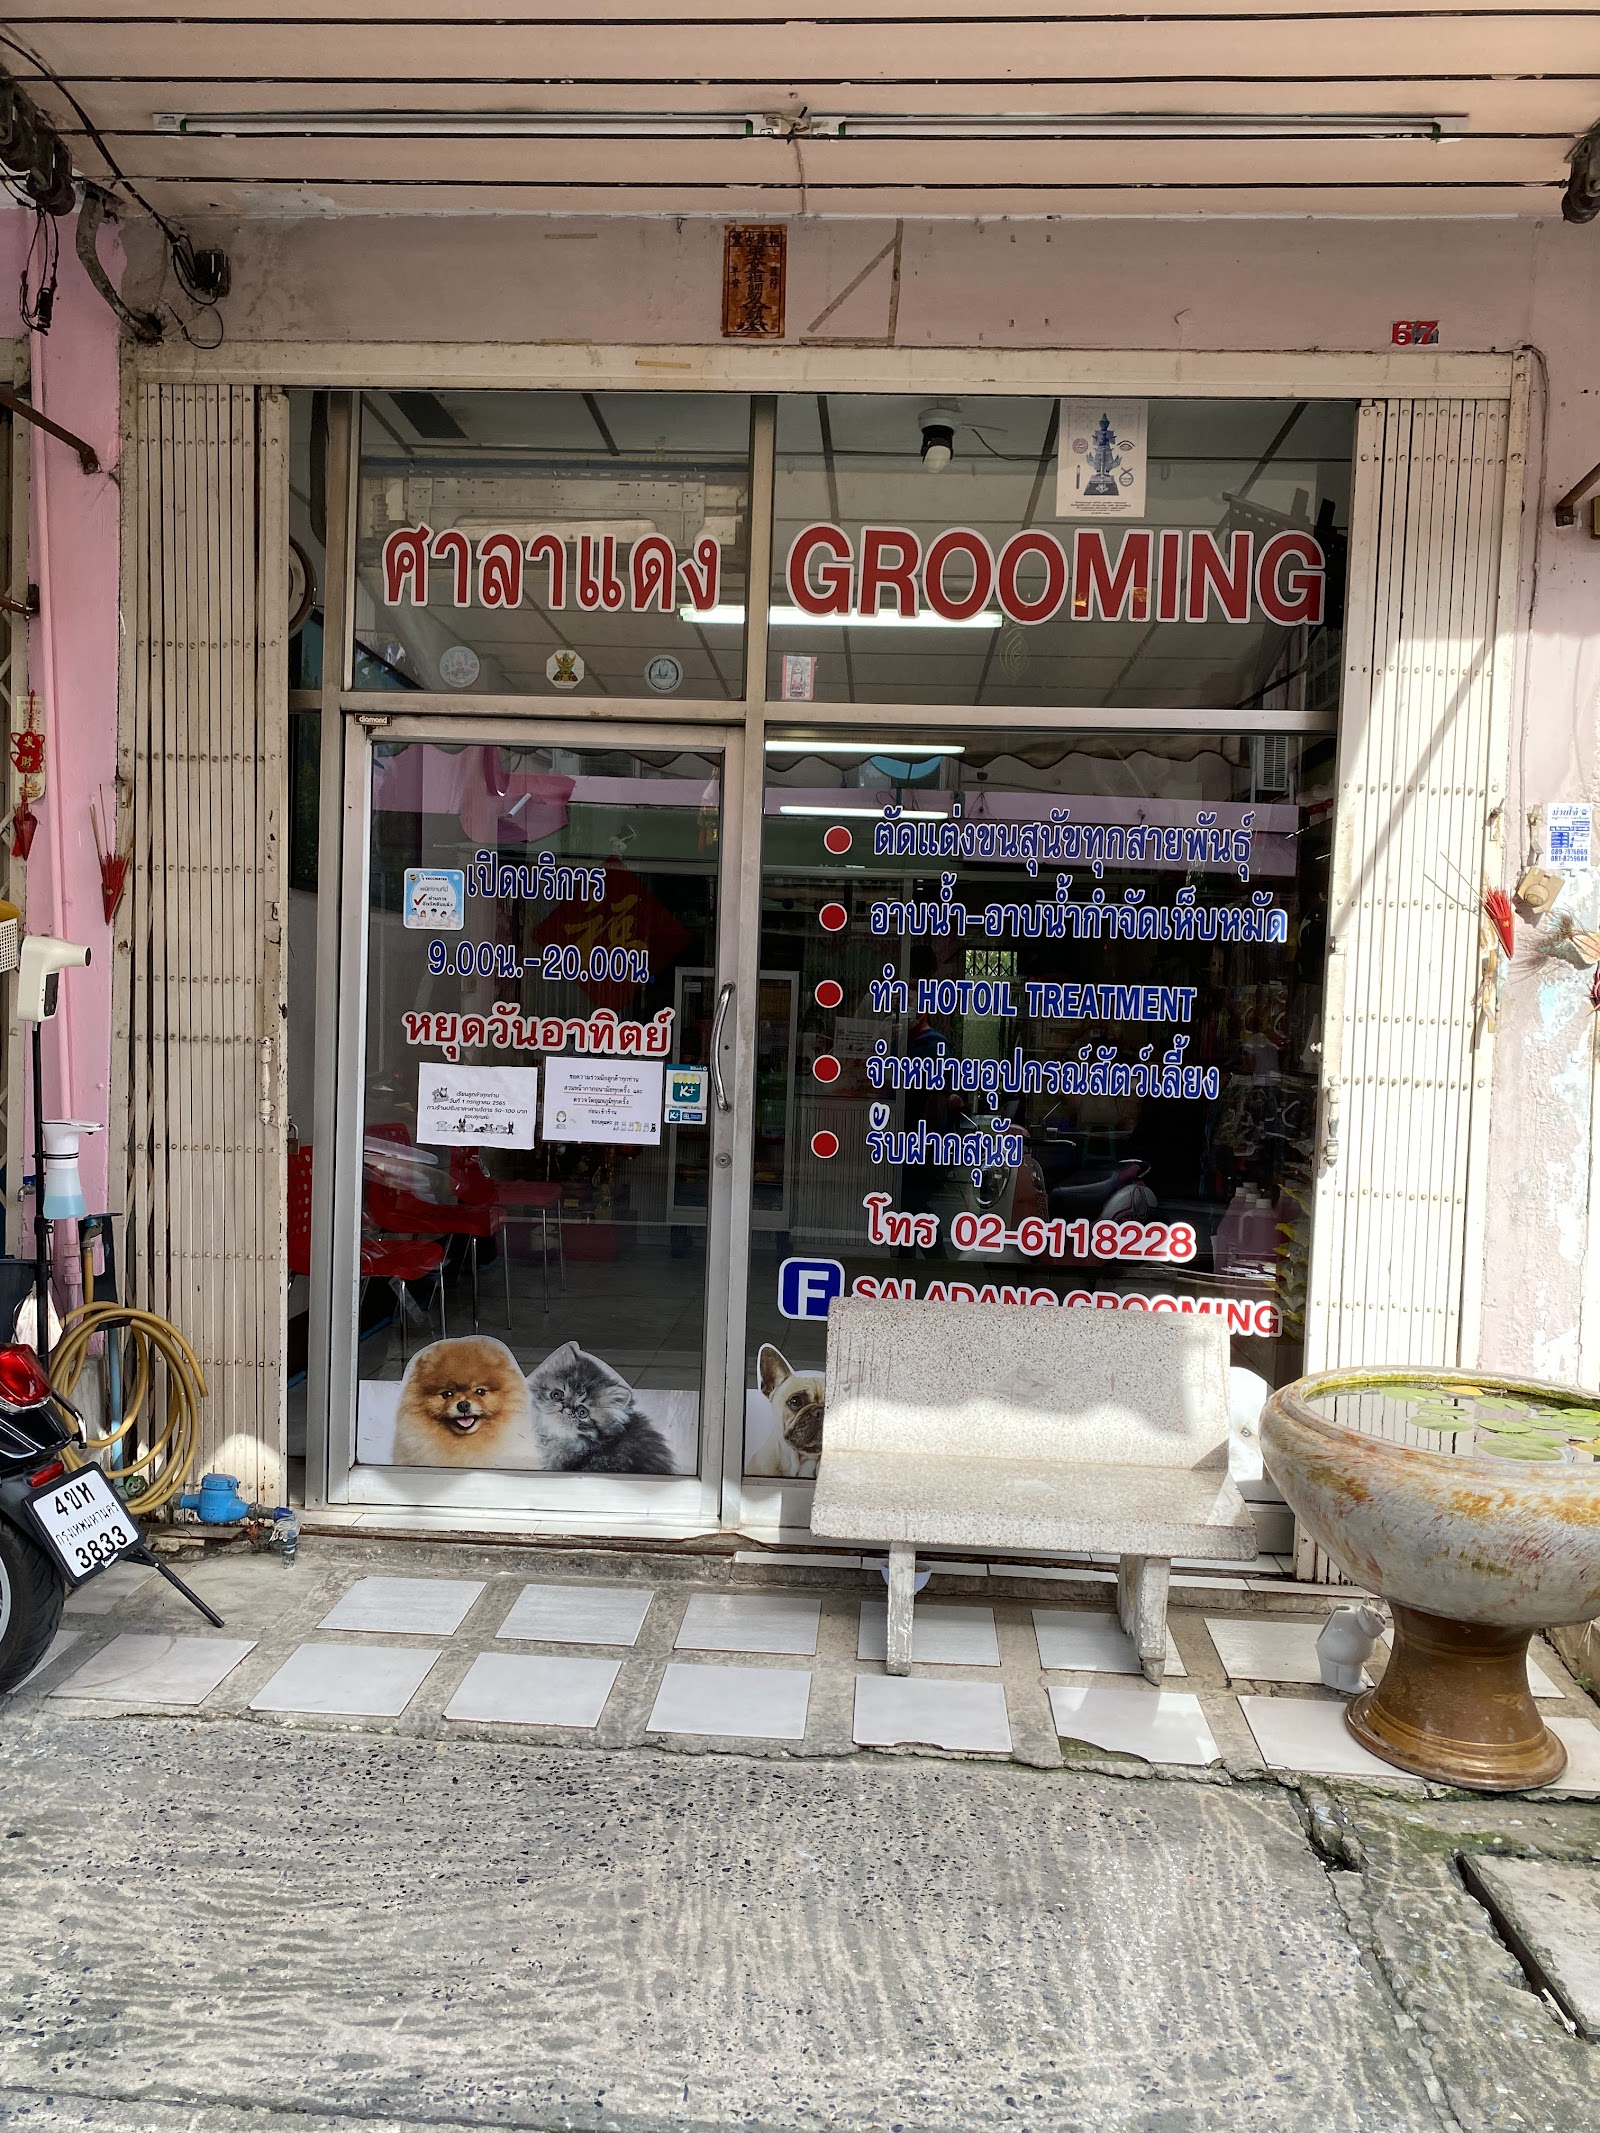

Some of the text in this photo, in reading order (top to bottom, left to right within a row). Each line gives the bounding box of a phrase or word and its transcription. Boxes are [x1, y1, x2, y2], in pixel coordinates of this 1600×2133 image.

[1392, 320, 1439, 346] 67
[382, 522, 721, 613] ศาลาแดง
[786, 522, 1325, 626] GROOMING
[466, 849, 606, 902] เปิดบริการ
[874, 804, 1255, 882] ตัดแต่งขนสุนัขทุกสายพันธุ์
[870, 871, 1288, 943] อาบน้ำ-อาบน้ำกำจัดเห็บหมัด
[870, 963, 1198, 1022] ทำ HOTOIL TREATMENT
[402, 1000, 676, 1062] หยุดวันอาทิตย์
[866, 1034, 1221, 1110] จำหน่ายอุปกรณ์สัตว์เลี้ยง
[866, 1102, 1023, 1187] รับฝากสุนัข
[863, 1191, 1198, 1264] โทร 02-6118228
[75, 1525, 128, 1569] 3833
